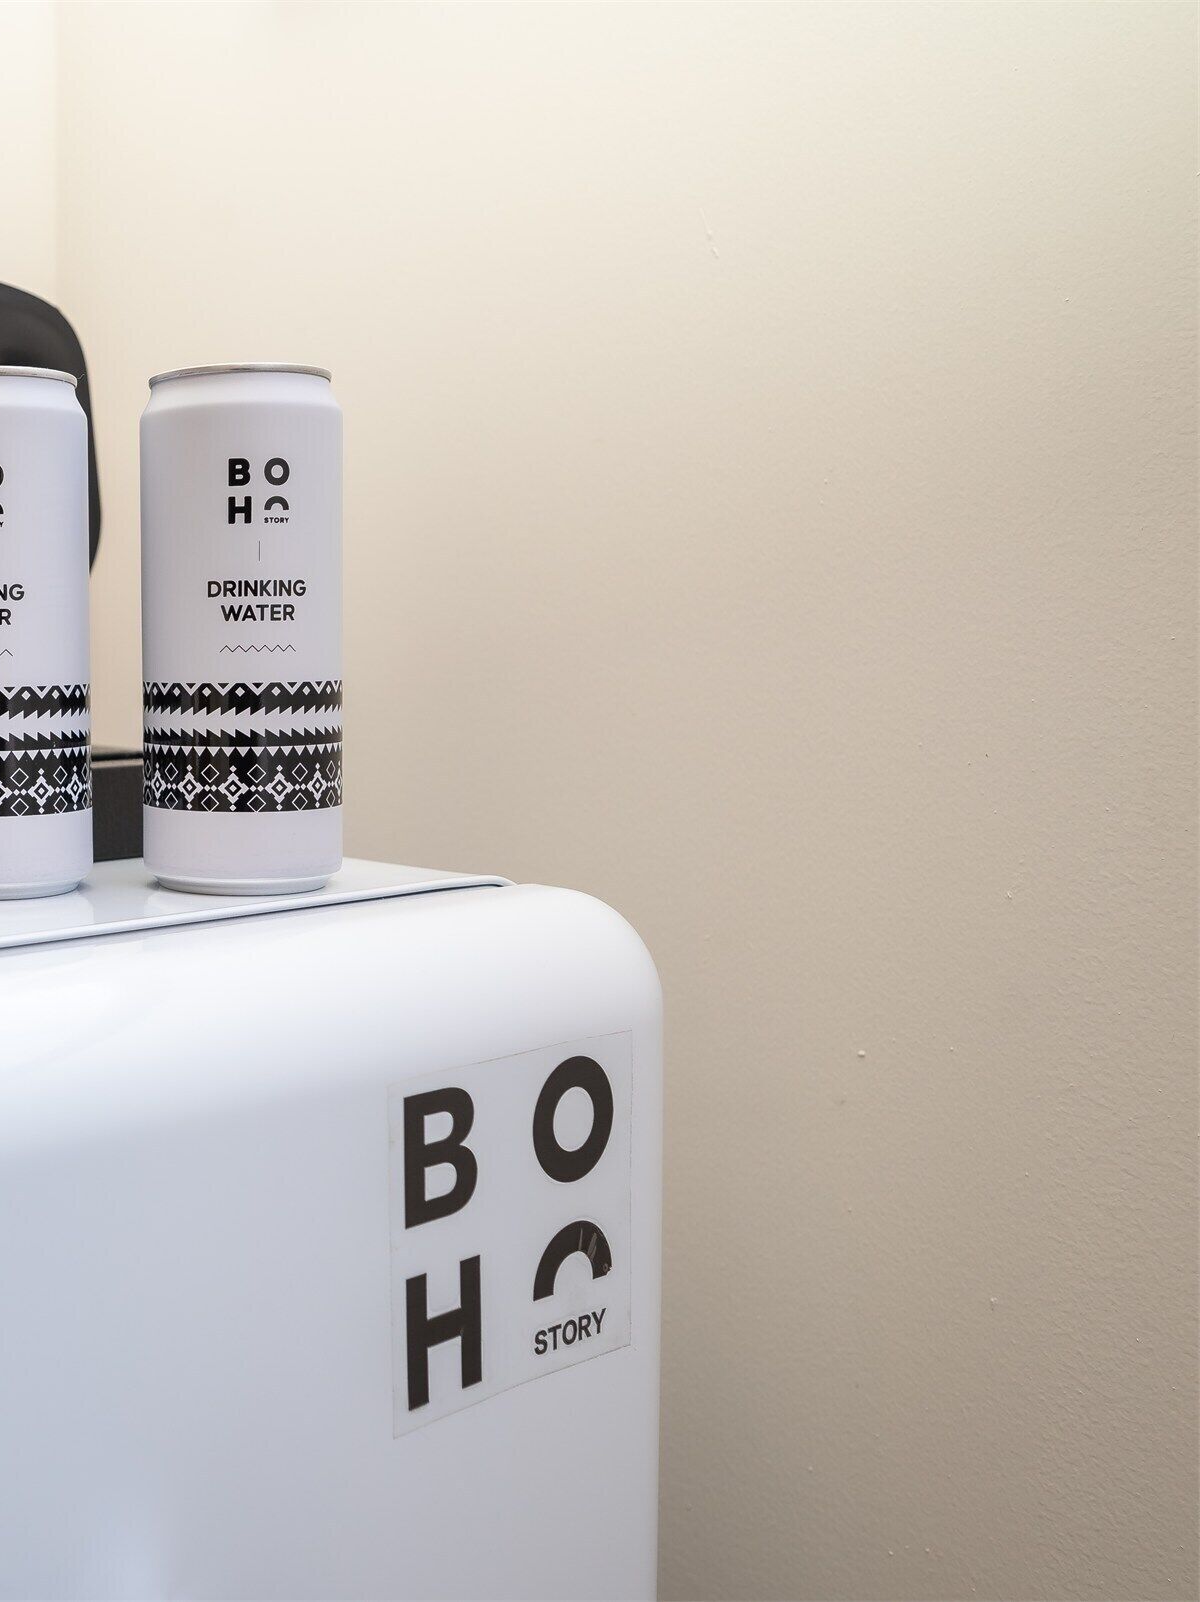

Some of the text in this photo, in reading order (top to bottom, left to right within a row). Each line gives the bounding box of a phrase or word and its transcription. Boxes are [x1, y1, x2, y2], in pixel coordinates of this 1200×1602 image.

[263, 516, 290, 524] STORY
[207, 579, 307, 598] DRINKING
[220, 603, 296, 622] WATER
[533, 1307, 607, 1357] STORY
